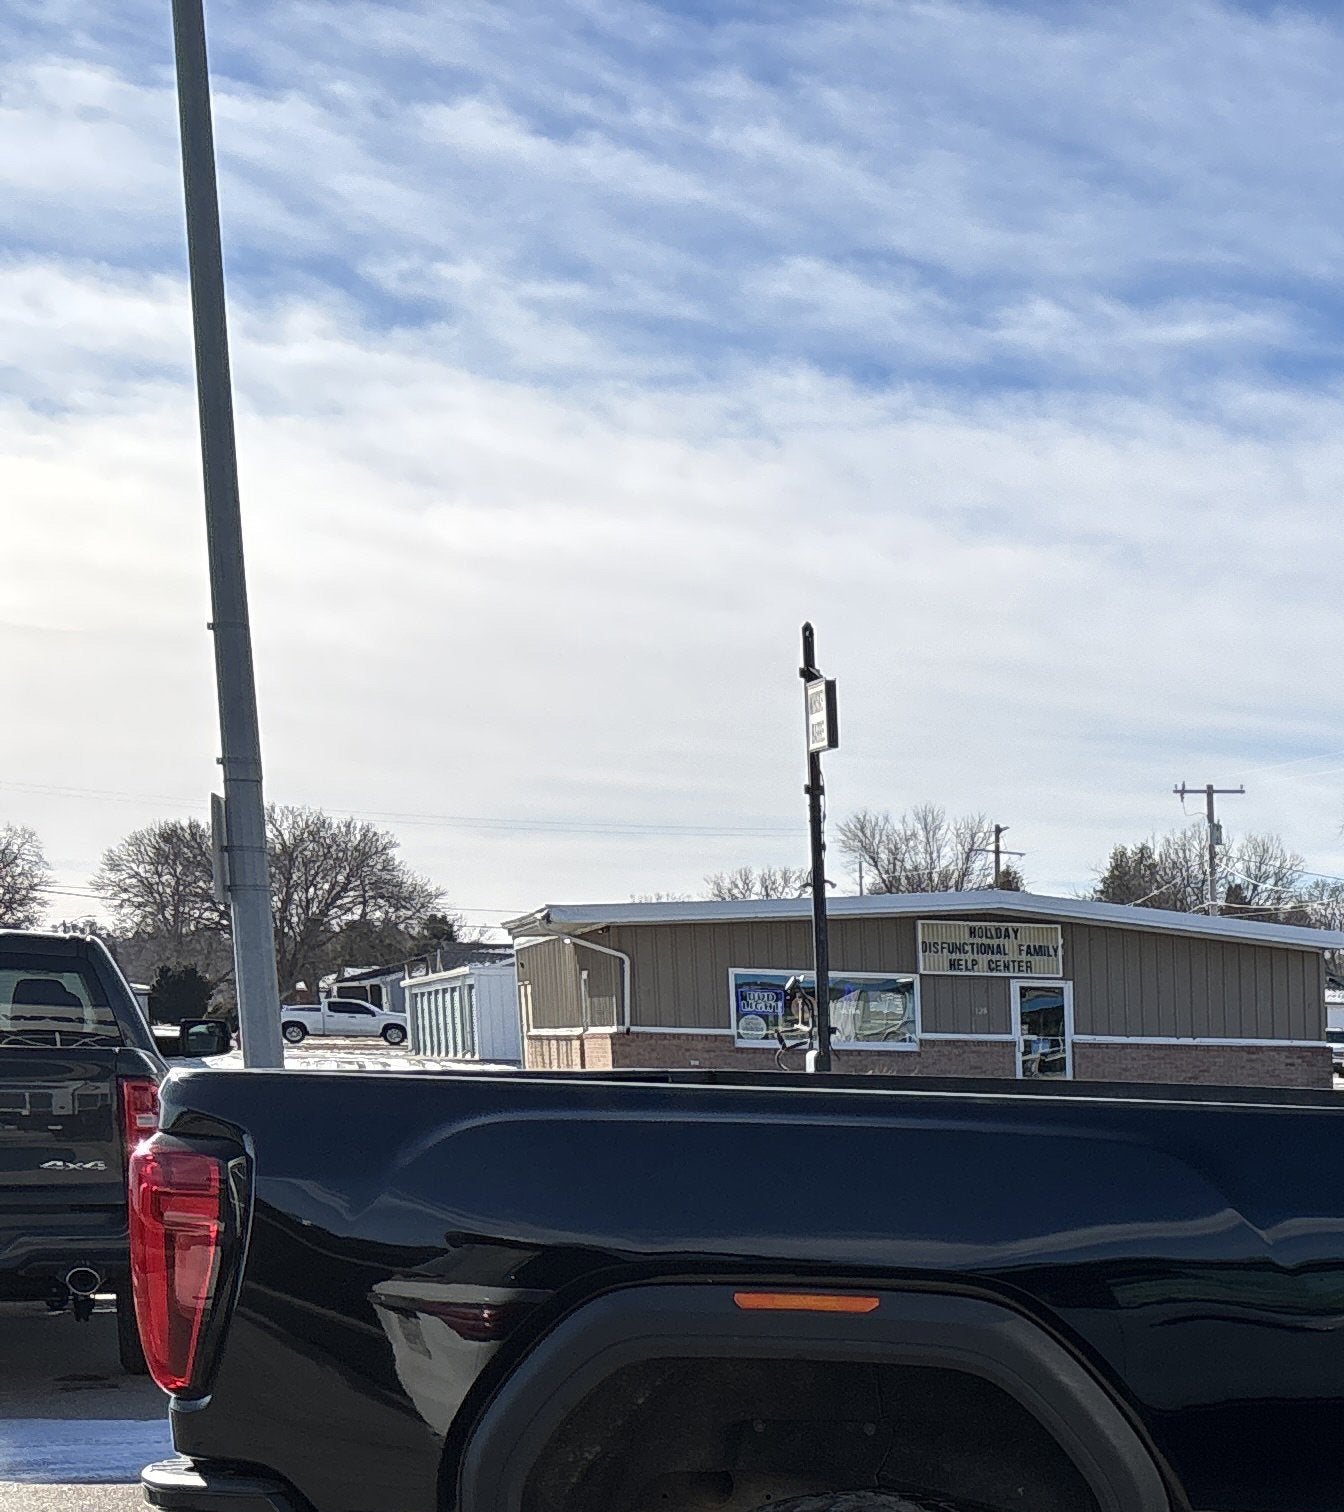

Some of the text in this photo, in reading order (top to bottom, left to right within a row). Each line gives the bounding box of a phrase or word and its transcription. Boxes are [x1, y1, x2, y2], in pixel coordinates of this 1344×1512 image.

[921, 941, 1060, 958] DISFUNCTIONAL FAMILY
[949, 958, 1033, 973] HELP CENTER
